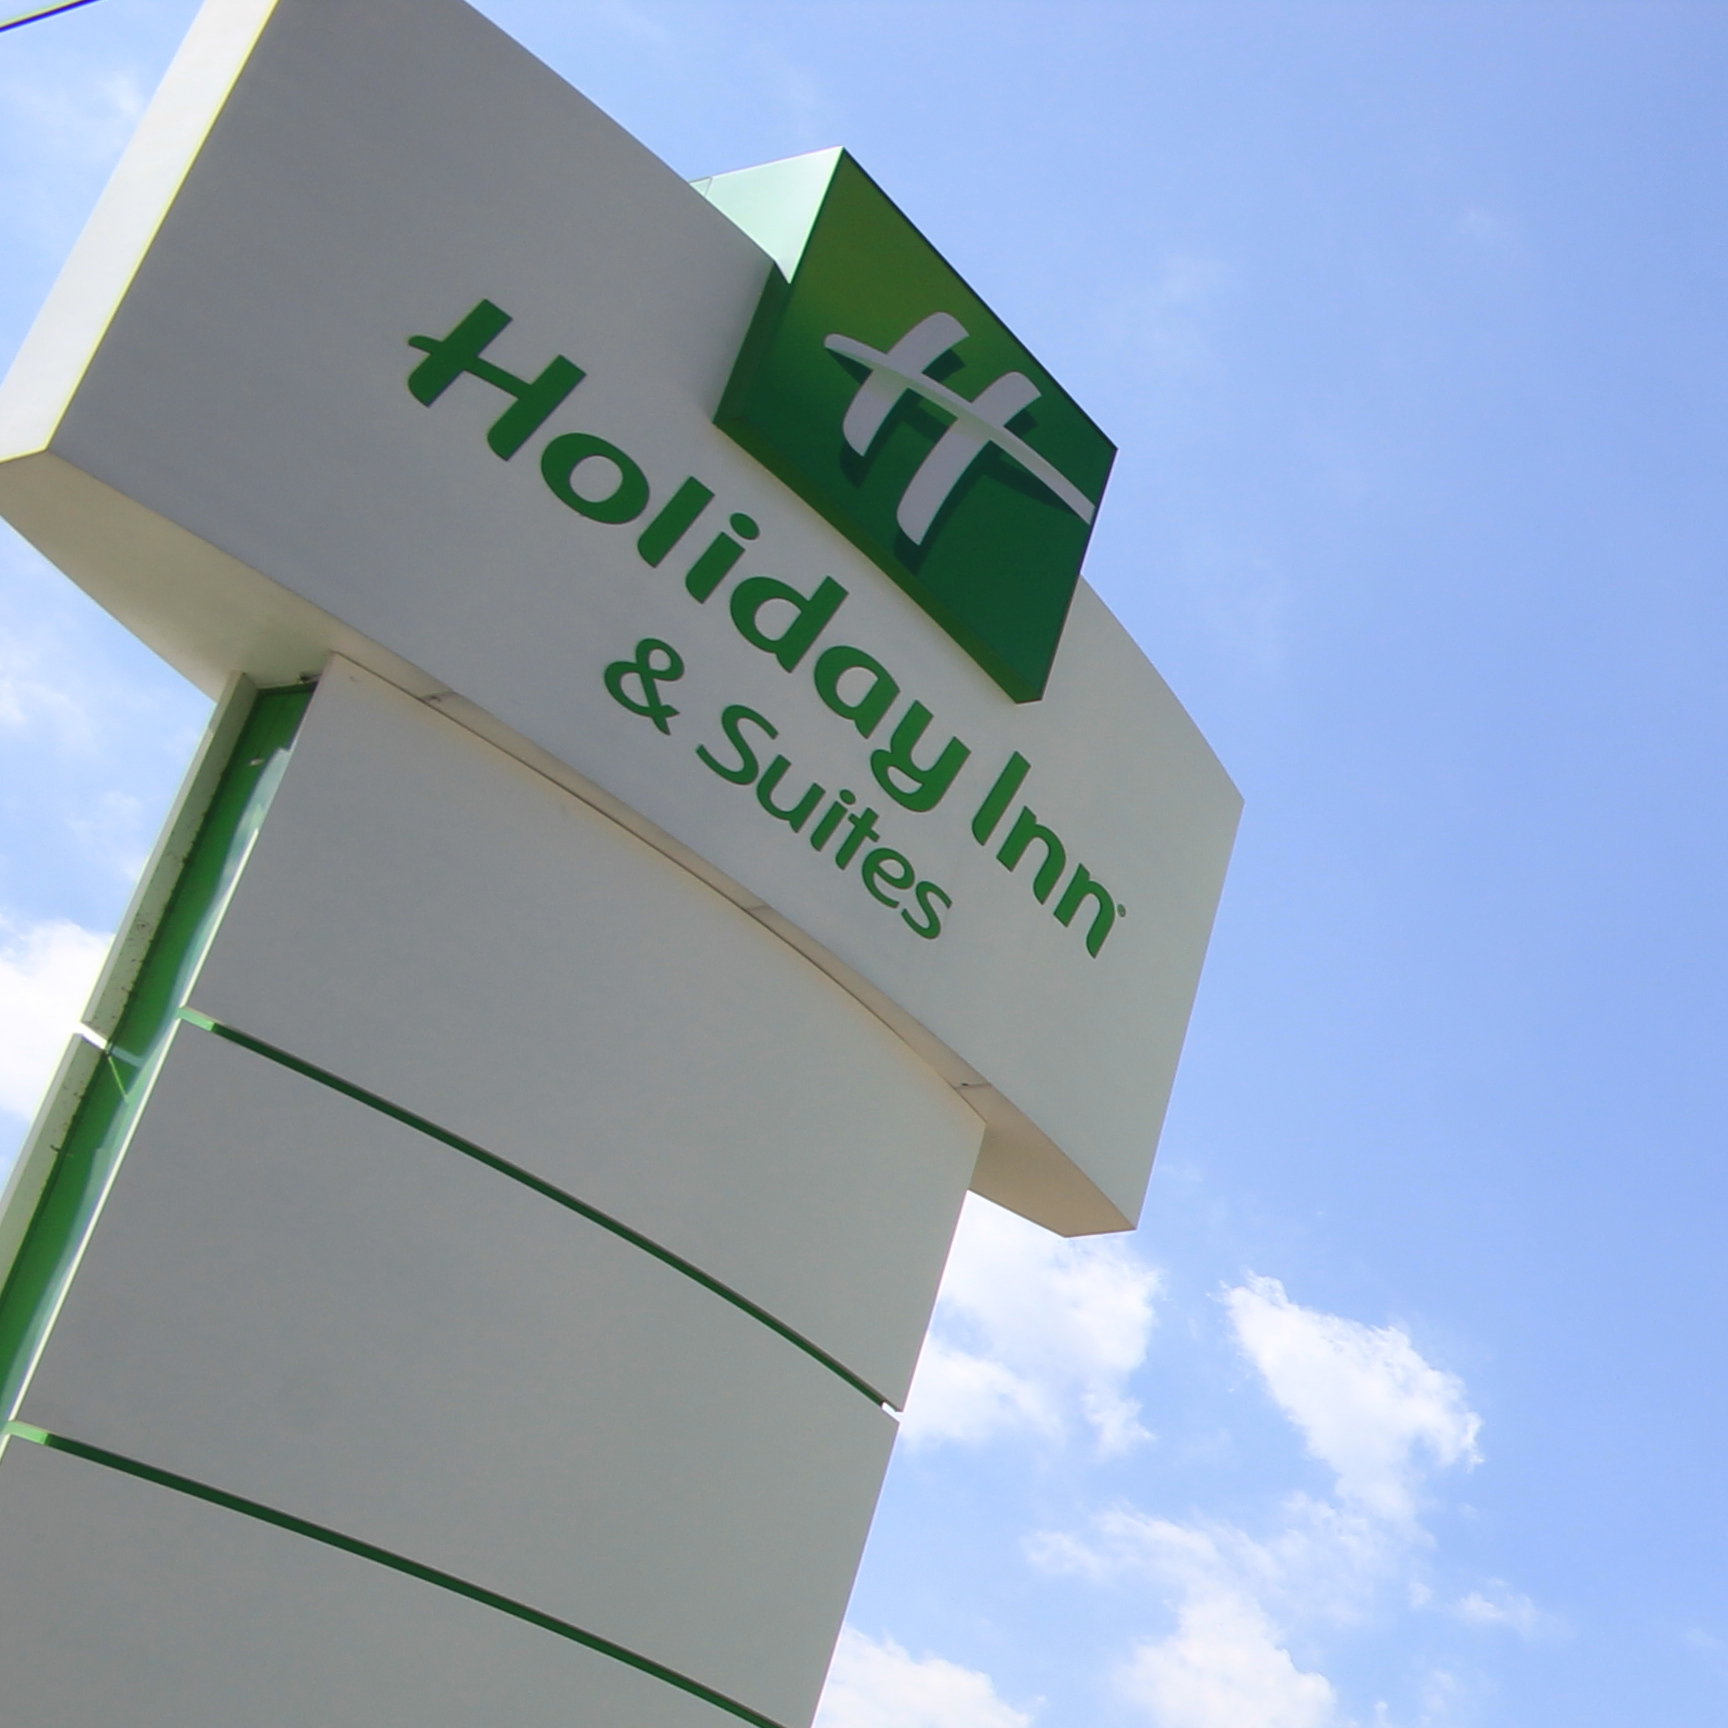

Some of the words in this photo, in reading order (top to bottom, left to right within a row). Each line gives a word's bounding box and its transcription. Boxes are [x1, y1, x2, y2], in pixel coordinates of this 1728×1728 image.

[407, 298, 970, 814] Holiday
[971, 752, 1117, 959] Inn
[603, 637, 681, 735] &
[696, 703, 952, 940] Suites
